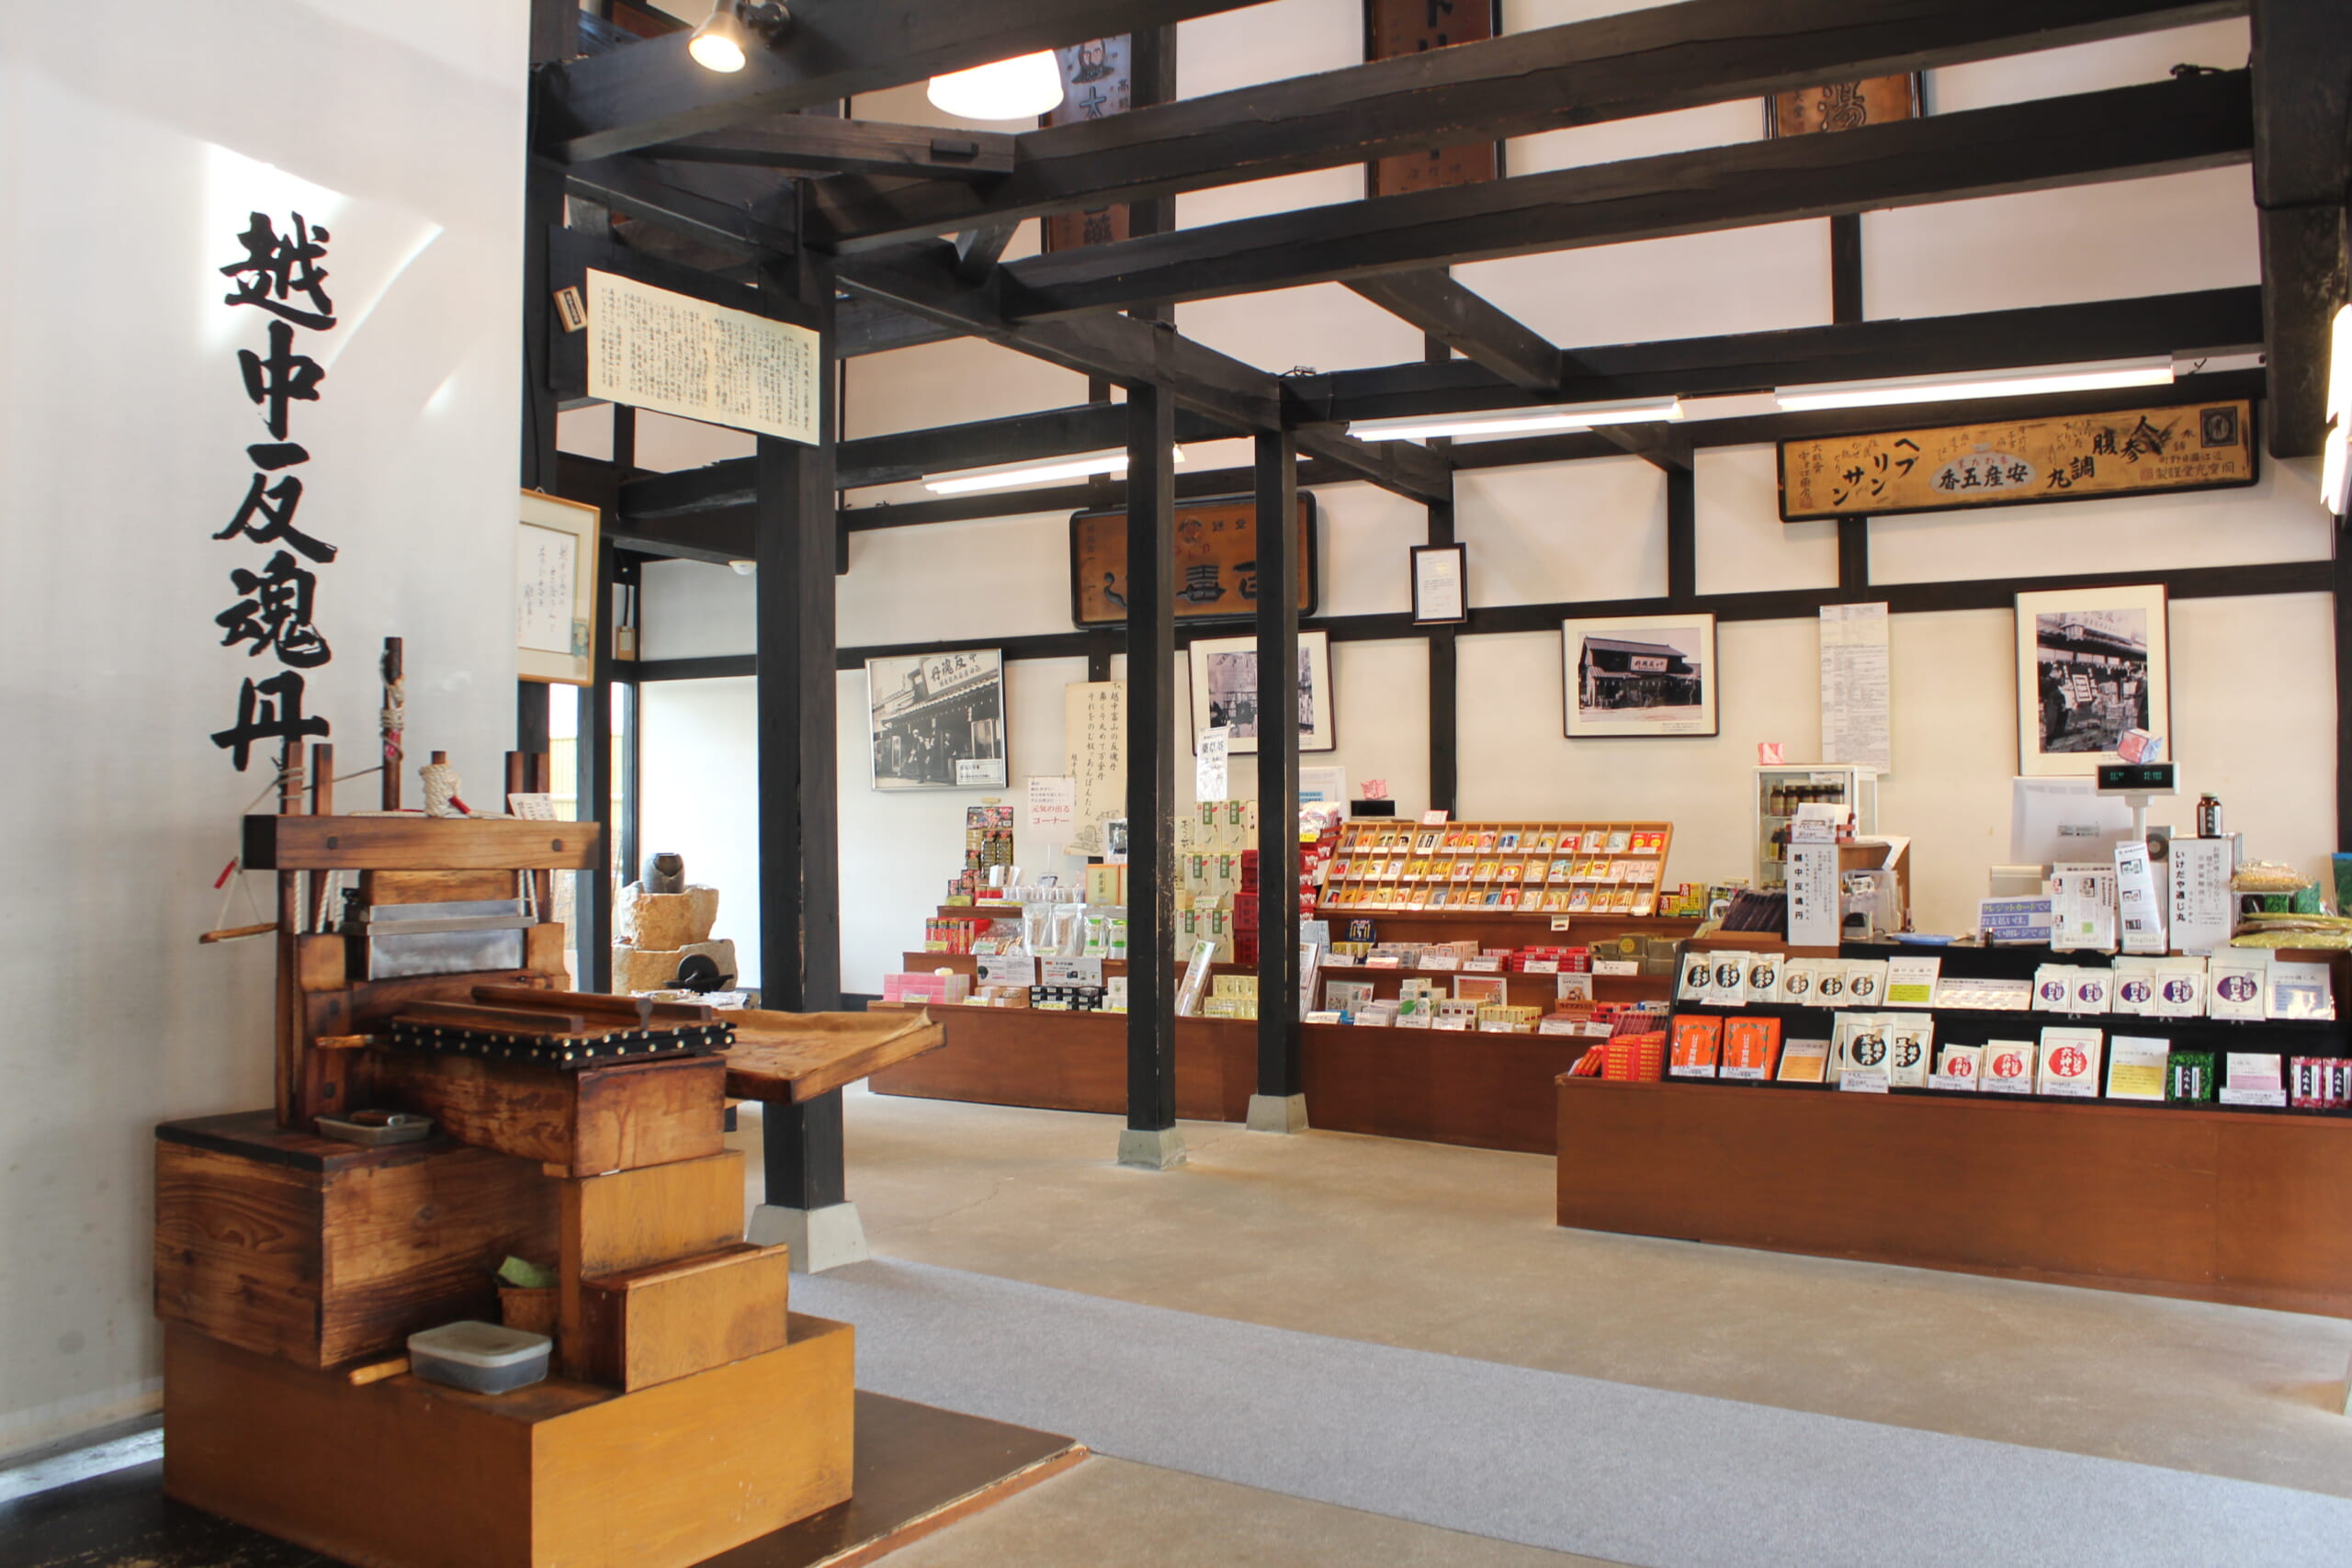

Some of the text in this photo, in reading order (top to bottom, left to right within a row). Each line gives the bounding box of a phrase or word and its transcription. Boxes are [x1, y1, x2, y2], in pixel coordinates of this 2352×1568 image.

[211, 210, 338, 772] 越中反魂丹
[1032, 817, 1069, 825] コーナー
[2176, 851, 2186, 922] いけだや通じ丸
